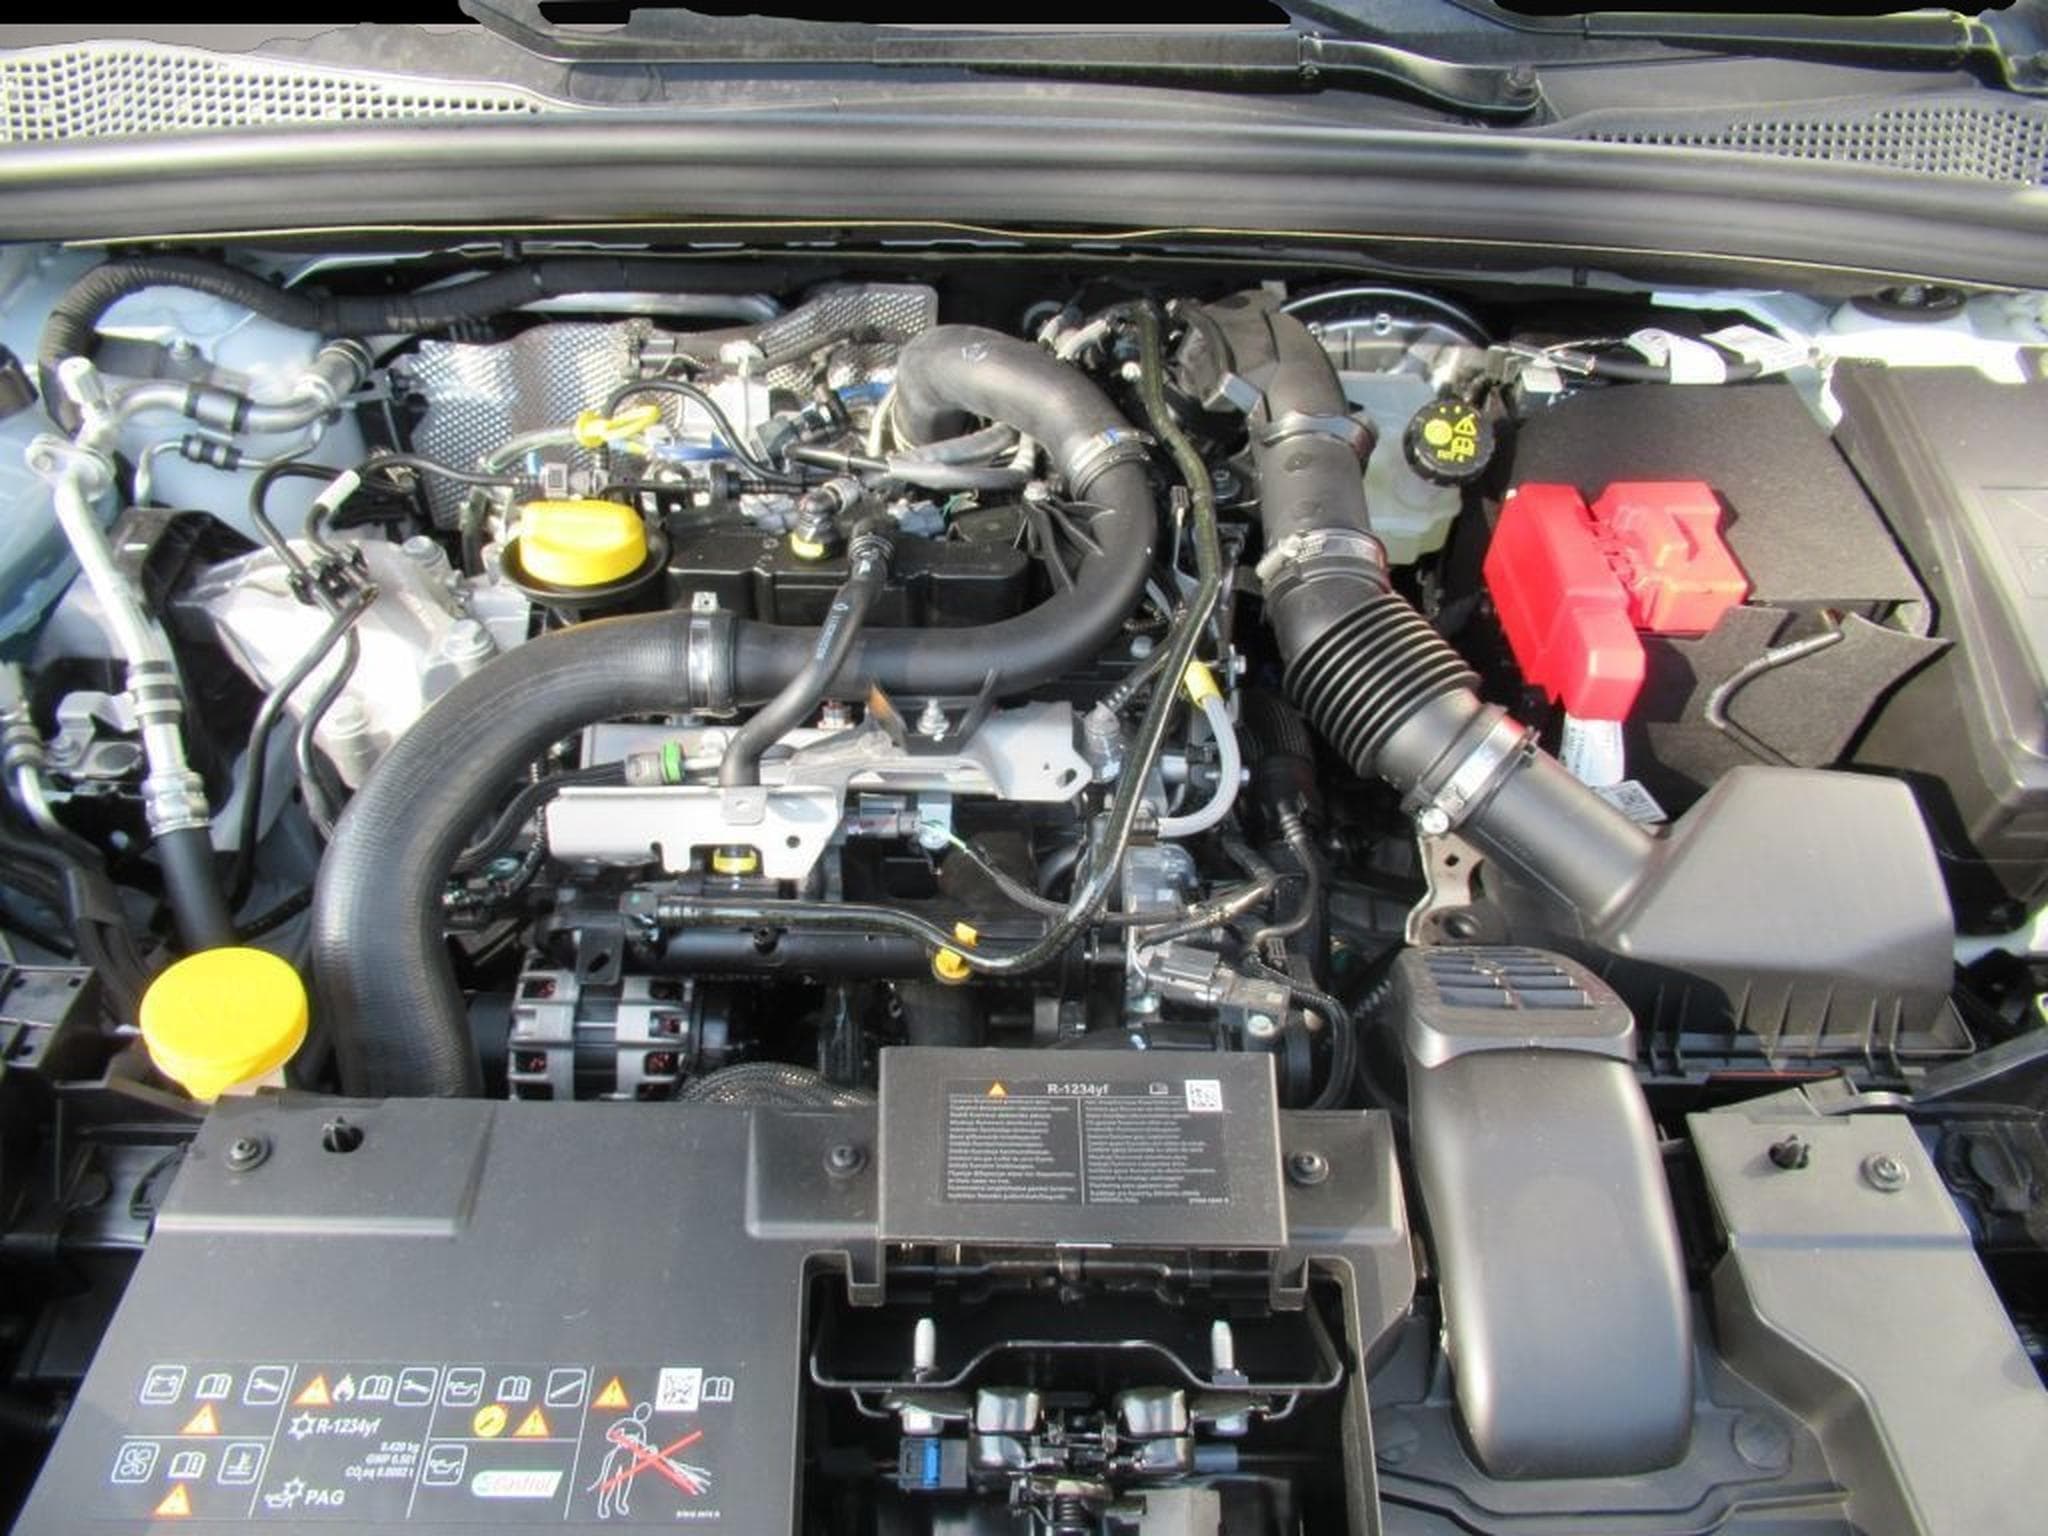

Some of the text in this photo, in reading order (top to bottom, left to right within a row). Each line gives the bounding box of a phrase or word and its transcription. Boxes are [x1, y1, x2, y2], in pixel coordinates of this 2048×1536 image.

[1047, 1083, 1109, 1098] R-1234yf
[316, 1417, 381, 1438] R-1234yf
[304, 1489, 346, 1506] PAG
